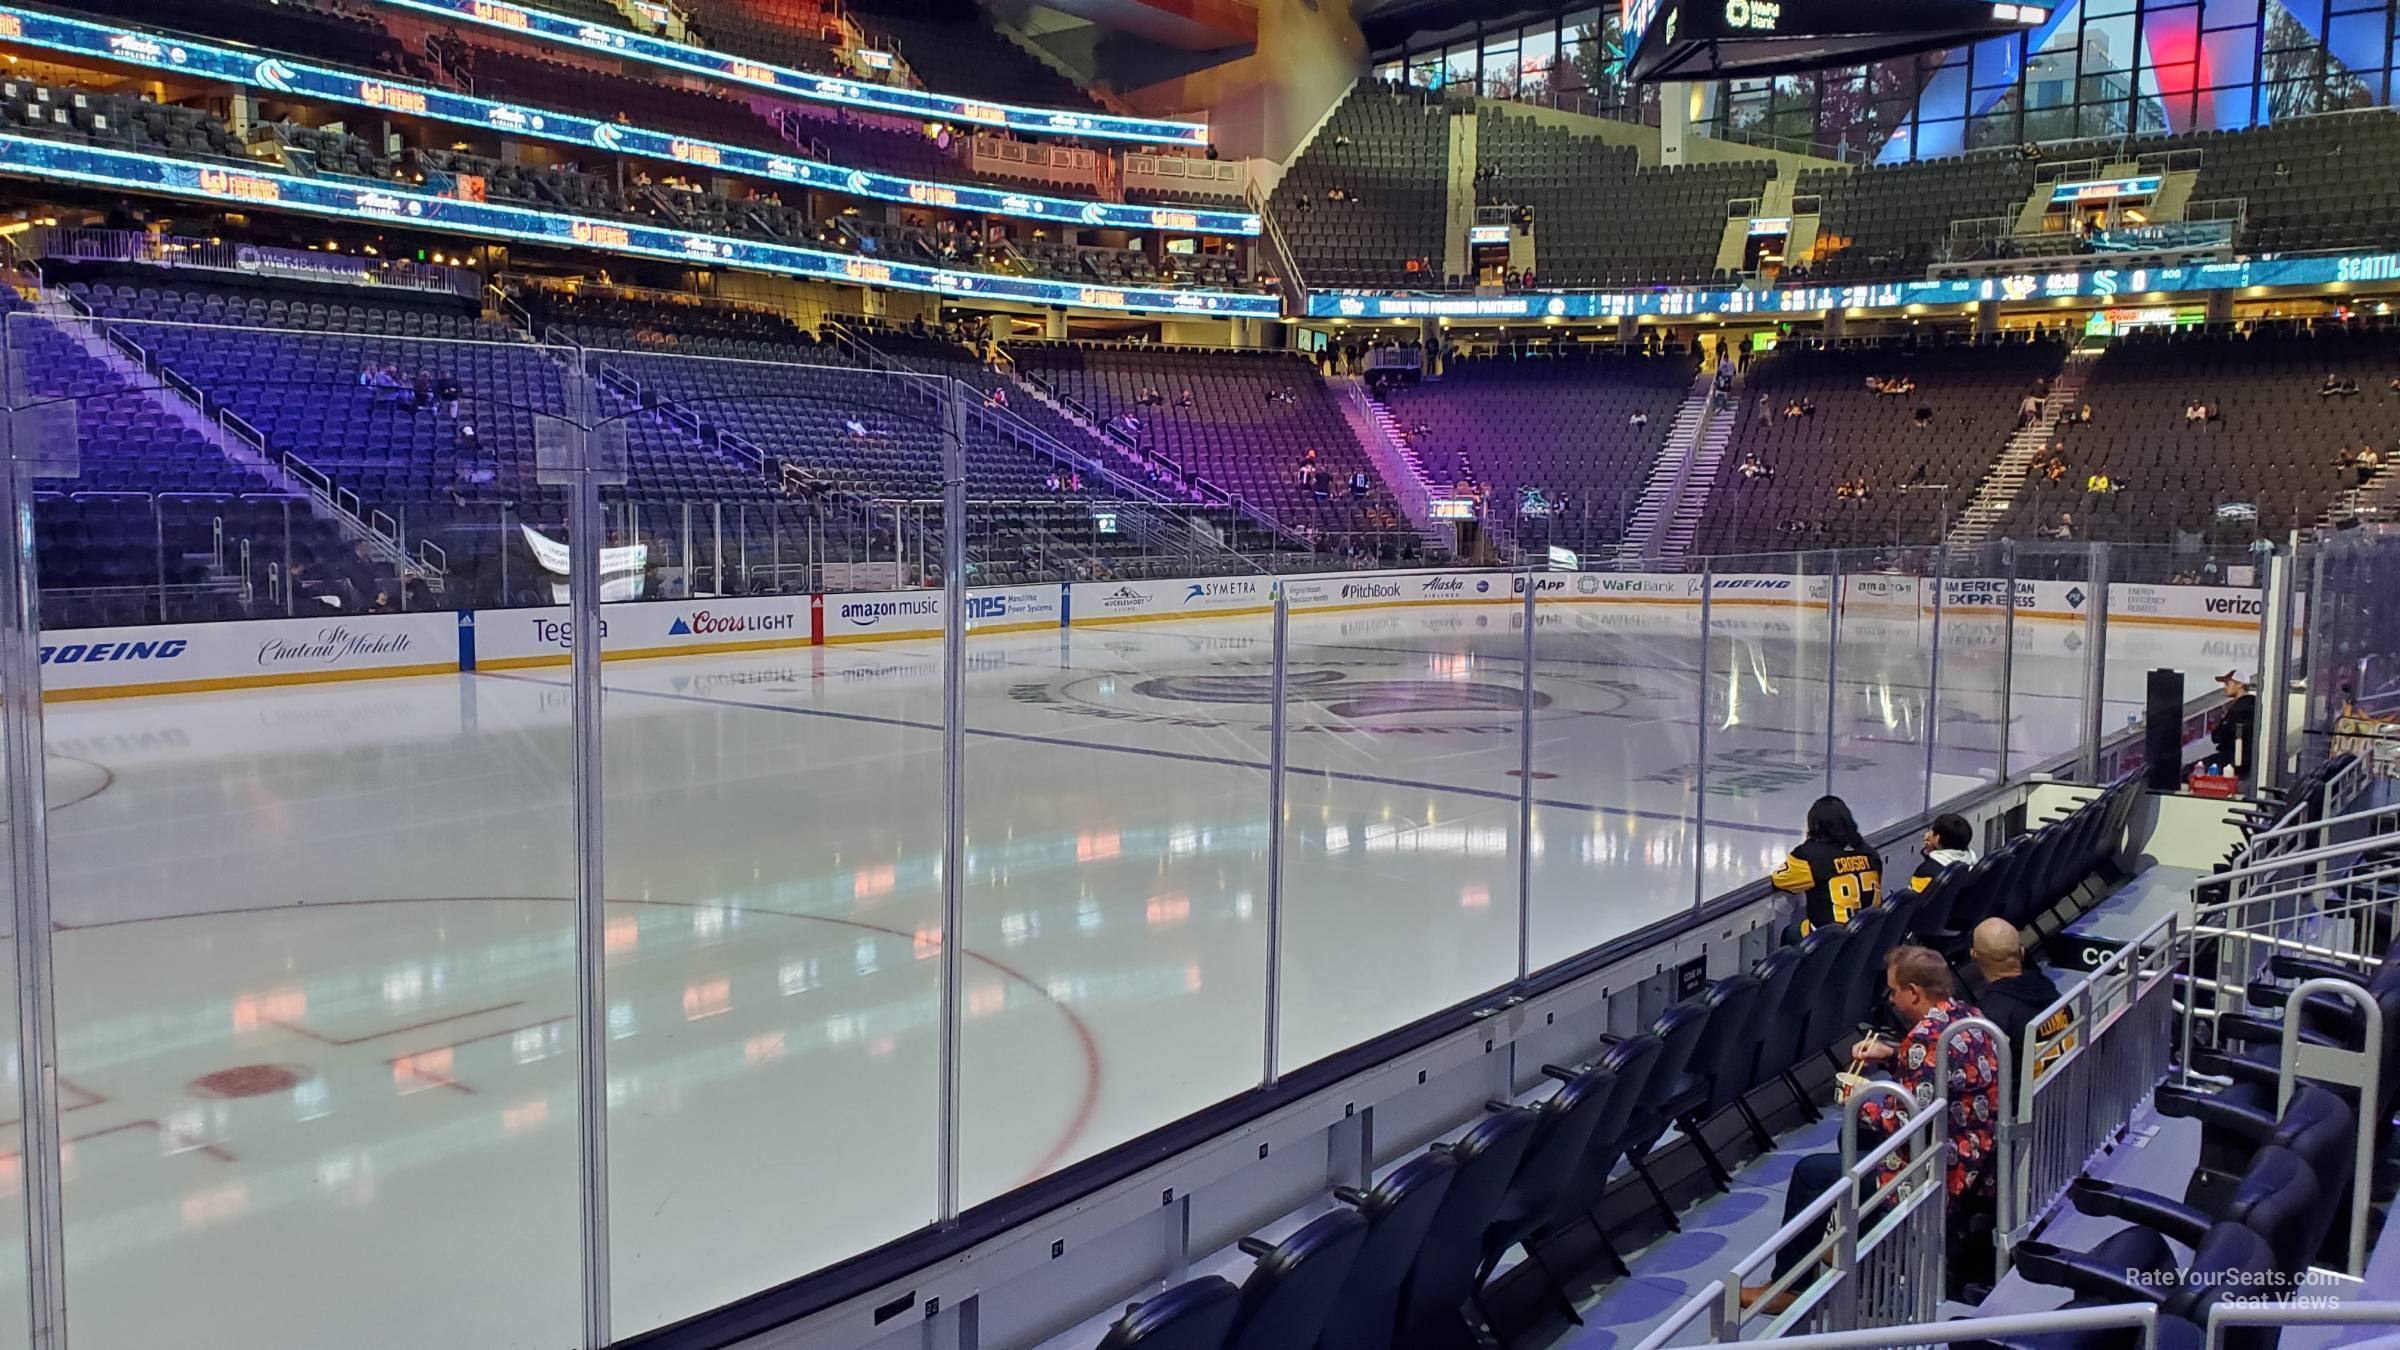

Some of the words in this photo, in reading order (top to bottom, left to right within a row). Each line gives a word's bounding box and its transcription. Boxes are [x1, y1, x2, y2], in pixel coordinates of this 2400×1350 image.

[1751, 1, 1780, 17] WaFd
[1752, 15, 1776, 30] Bank
[1379, 300, 1408, 313] THANK
[1410, 300, 1429, 313] YOU
[1430, 300, 1476, 313] FOUNDING
[1478, 300, 1527, 313] PARTNERS
[1206, 581, 1256, 595] SYMETRA
[1351, 582, 1400, 598] PitchBook
[1422, 577, 1463, 591] Alaska
[1603, 580, 1642, 591] WaFd
[1644, 581, 1675, 592] Bank
[1713, 580, 1791, 589] BOEING
[1008, 594, 1037, 602] Monolithic
[1104, 598, 1144, 607] MUCKLESHOOT
[2205, 594, 2264, 615] verizo
[841, 602, 896, 618] amazon
[899, 596, 939, 615] music
[1008, 604, 1025, 613] Power
[1027, 604, 1052, 613] Systems
[692, 610, 745, 635] Coors
[748, 613, 794, 631] LIGHT
[532, 618, 608, 648] Tega
[258, 637, 334, 666] Chateau
[332, 632, 411, 664] Michelle
[1833, 855, 1870, 874] CROSBY
[926, 1301, 938, 1315] 22
